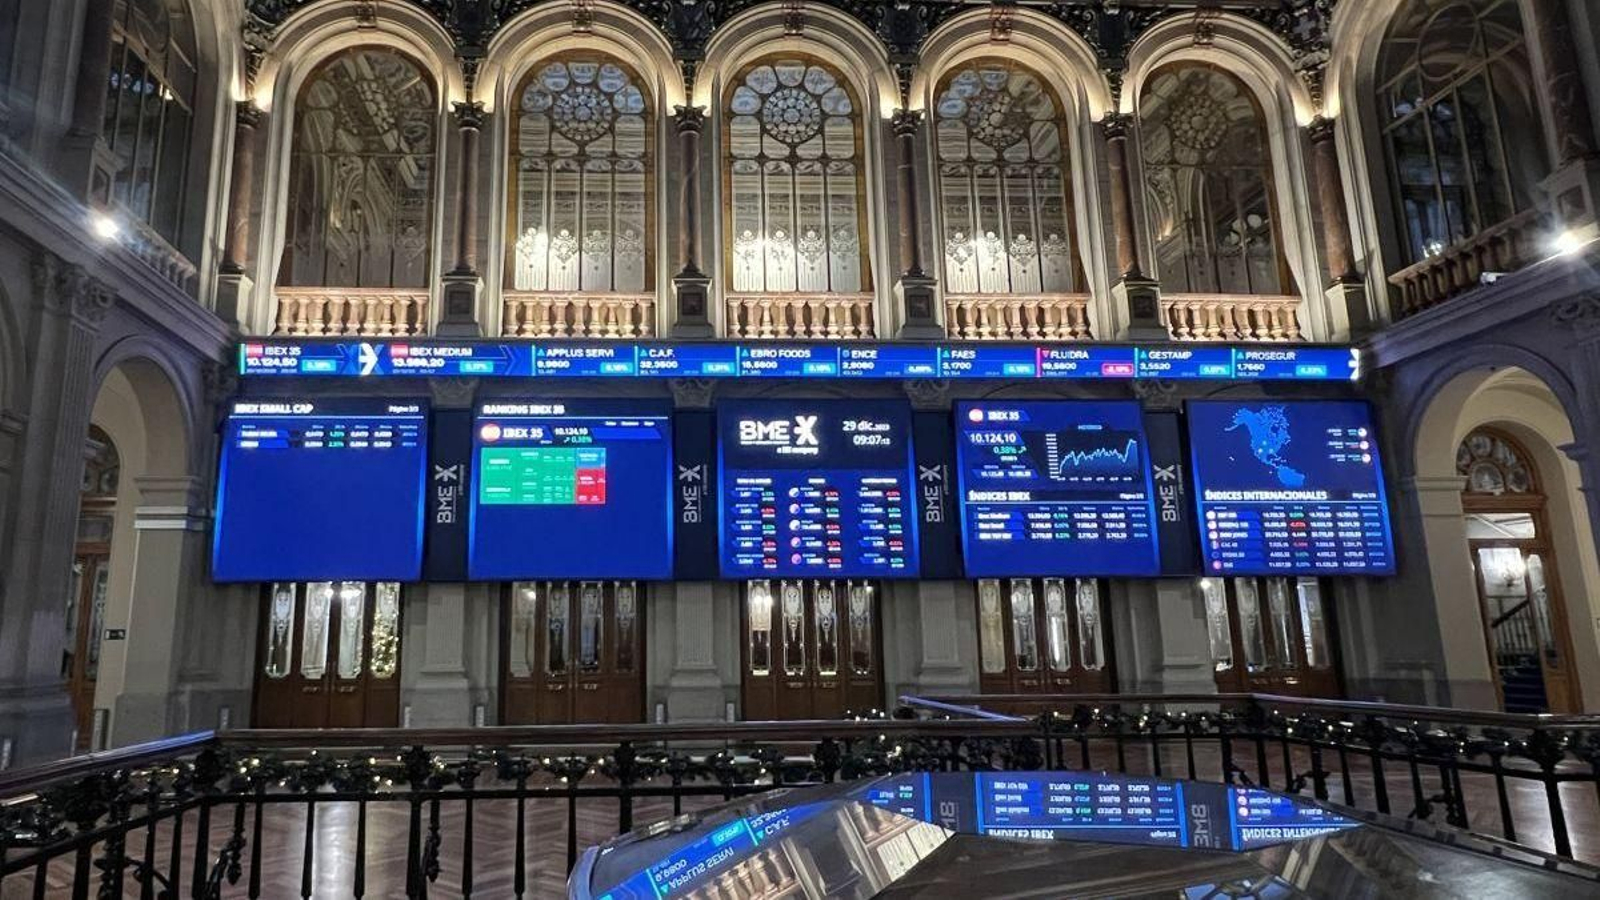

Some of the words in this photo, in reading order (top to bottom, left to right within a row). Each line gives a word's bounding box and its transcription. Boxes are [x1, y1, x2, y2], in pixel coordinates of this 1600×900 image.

[264, 346, 288, 356] IBEX
[410, 347, 432, 357] IBEX
[434, 347, 473, 357] MEDIUM
[546, 348, 584, 358] APPLUS
[585, 348, 614, 358] SERVI
[648, 349, 676, 358] C.A.F.
[750, 349, 777, 358] EBRO
[778, 349, 811, 358] FOODS
[851, 350, 878, 359] ENCE
[951, 350, 976, 359] FAES
[1050, 350, 1089, 360] FLUIDRA
[1148, 351, 1193, 360] GESTAMP
[1246, 351, 1296, 360] PROSEGUR
[293, 404, 313, 414] CAP
[740, 420, 790, 440] BME
[842, 420, 856, 431] 29
[503, 428, 528, 438] IBEX
[530, 428, 544, 438] 35
[968, 490, 1007, 500] ÍNDICES
[1204, 489, 1242, 500] ÍNDICES
[1243, 491, 1328, 500] INTERNACIONALES
[437, 486, 453, 523] BME
[683, 486, 698, 523] BME
[924, 485, 940, 522] BME
[1160, 485, 1176, 522] BME
